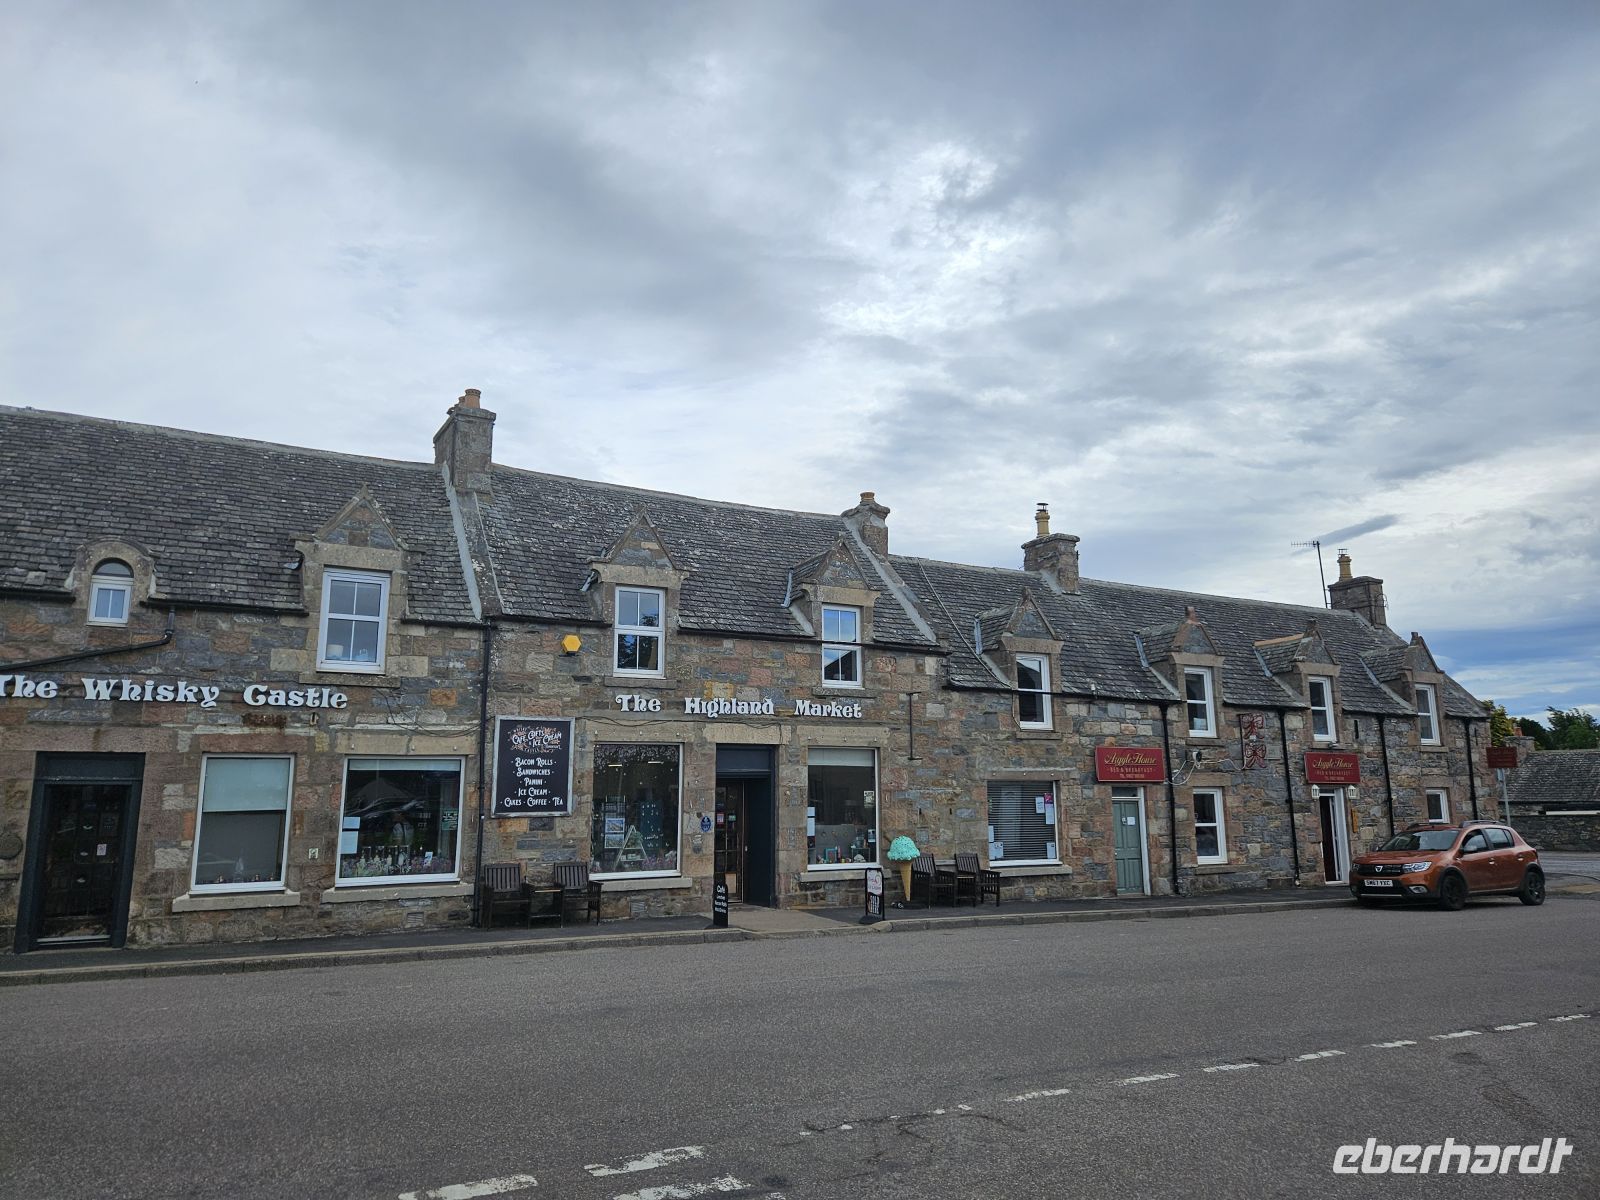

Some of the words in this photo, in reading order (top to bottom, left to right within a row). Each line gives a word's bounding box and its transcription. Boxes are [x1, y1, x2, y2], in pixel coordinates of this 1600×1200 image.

[81, 677, 220, 708] Whisky
[243, 684, 348, 709] Castle
[615, 694, 661, 712] The
[684, 696, 775, 718] Highland
[794, 699, 862, 718] Market
[1131, 752, 1157, 764] House
